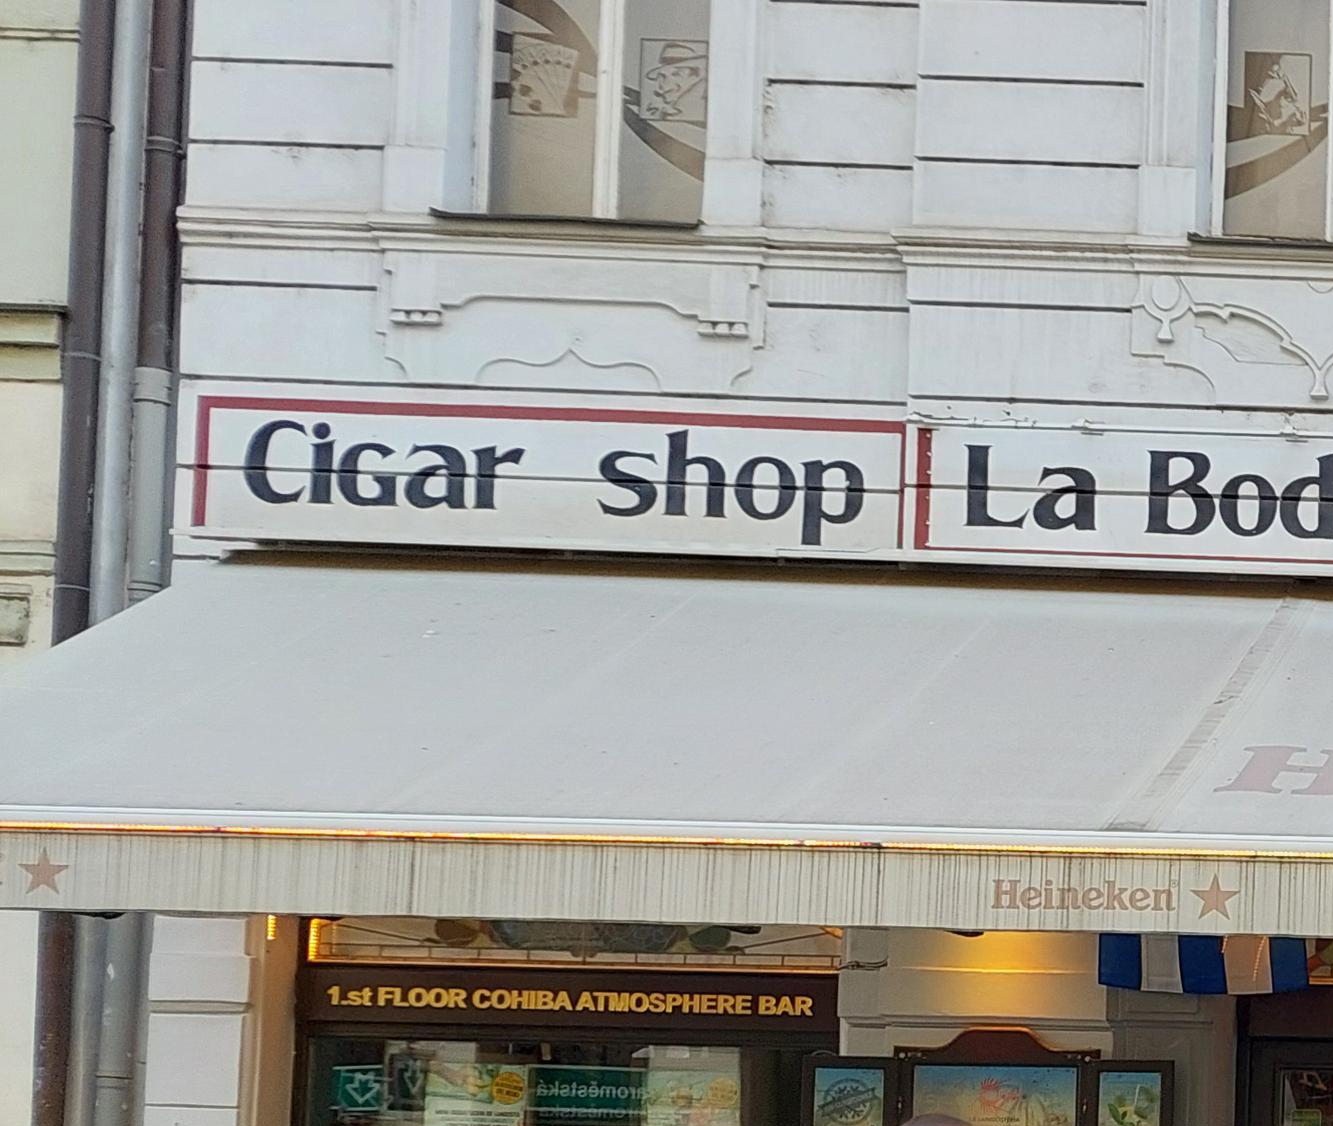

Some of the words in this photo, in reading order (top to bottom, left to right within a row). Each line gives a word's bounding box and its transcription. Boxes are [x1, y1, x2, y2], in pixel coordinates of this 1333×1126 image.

[245, 420, 525, 512] Cigar
[598, 431, 865, 546] shop
[964, 444, 1097, 530] La
[377, 987, 467, 1008] FLOOR
[472, 988, 573, 1011] COHIBA
[575, 992, 752, 1014] ATMOSPHERE
[758, 995, 813, 1016] BAR
